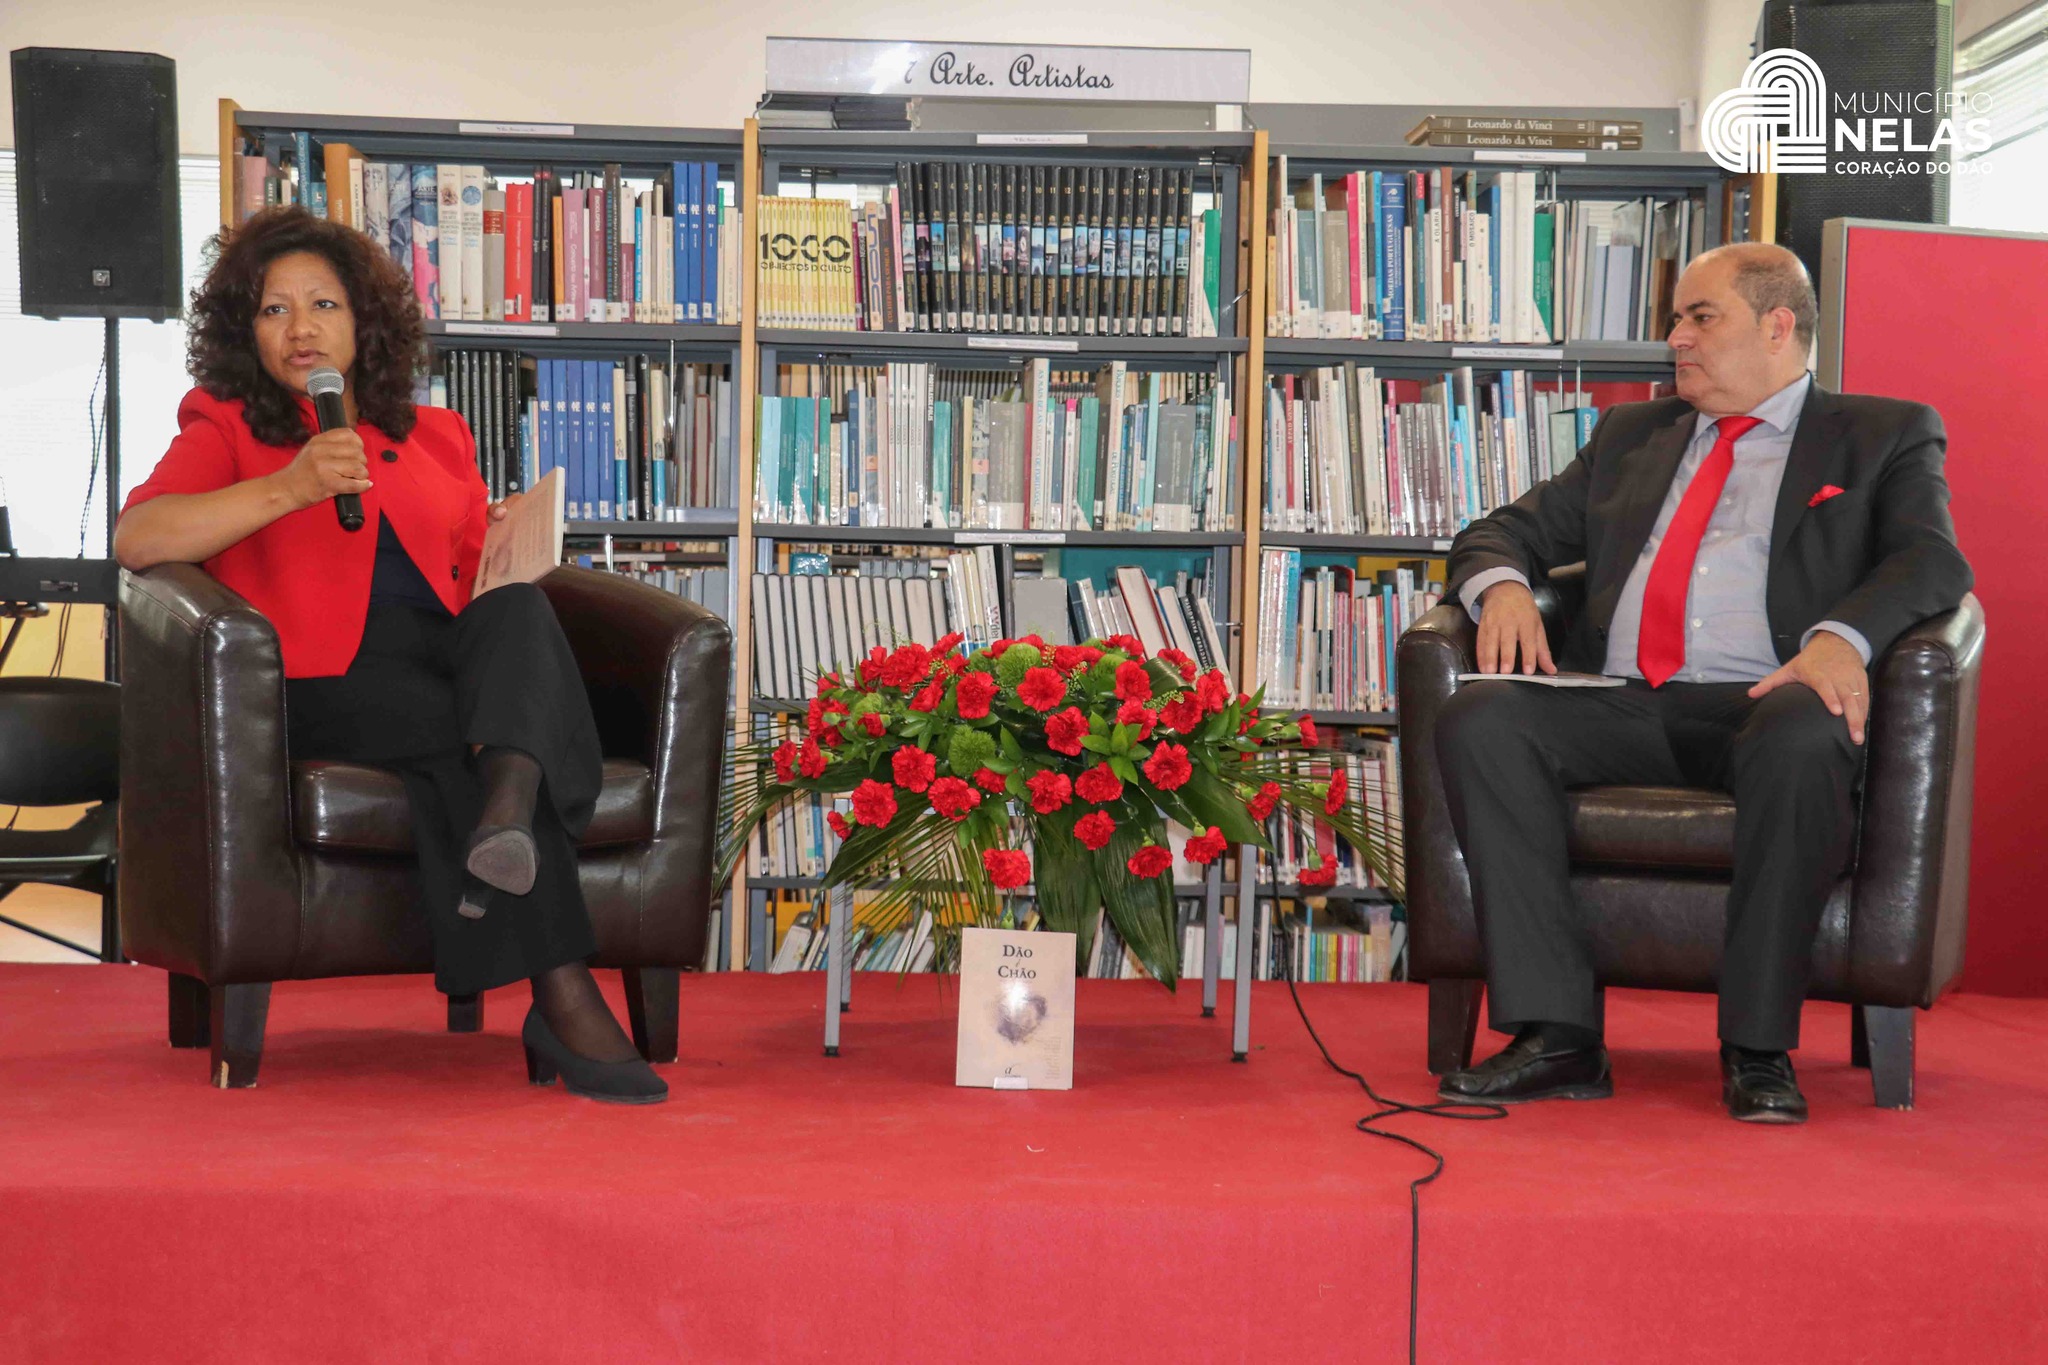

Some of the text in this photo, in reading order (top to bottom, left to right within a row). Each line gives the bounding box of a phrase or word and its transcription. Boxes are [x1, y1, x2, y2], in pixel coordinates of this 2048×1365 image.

[930, 51, 994, 86] Arte.
[1008, 53, 1114, 89] Artistas
[1466, 119, 1513, 130] Leonardo
[1514, 120, 1526, 130] da
[1527, 120, 1553, 131] Vinci
[1466, 135, 1513, 145] Leonardo
[1514, 135, 1526, 145] da
[1527, 136, 1553, 146] Vinci
[1035, 186, 1042, 194] 10
[1138, 188, 1145, 196] 17
[1168, 187, 1175, 195] 19
[1182, 187, 1190, 195] 20
[760, 232, 851, 263] 1000
[1386, 214, 1394, 298] MOEDAS PORTUGUESAS
[820, 263, 852, 274] CULTO
[1184, 598, 1198, 634] PAISAGISTA
